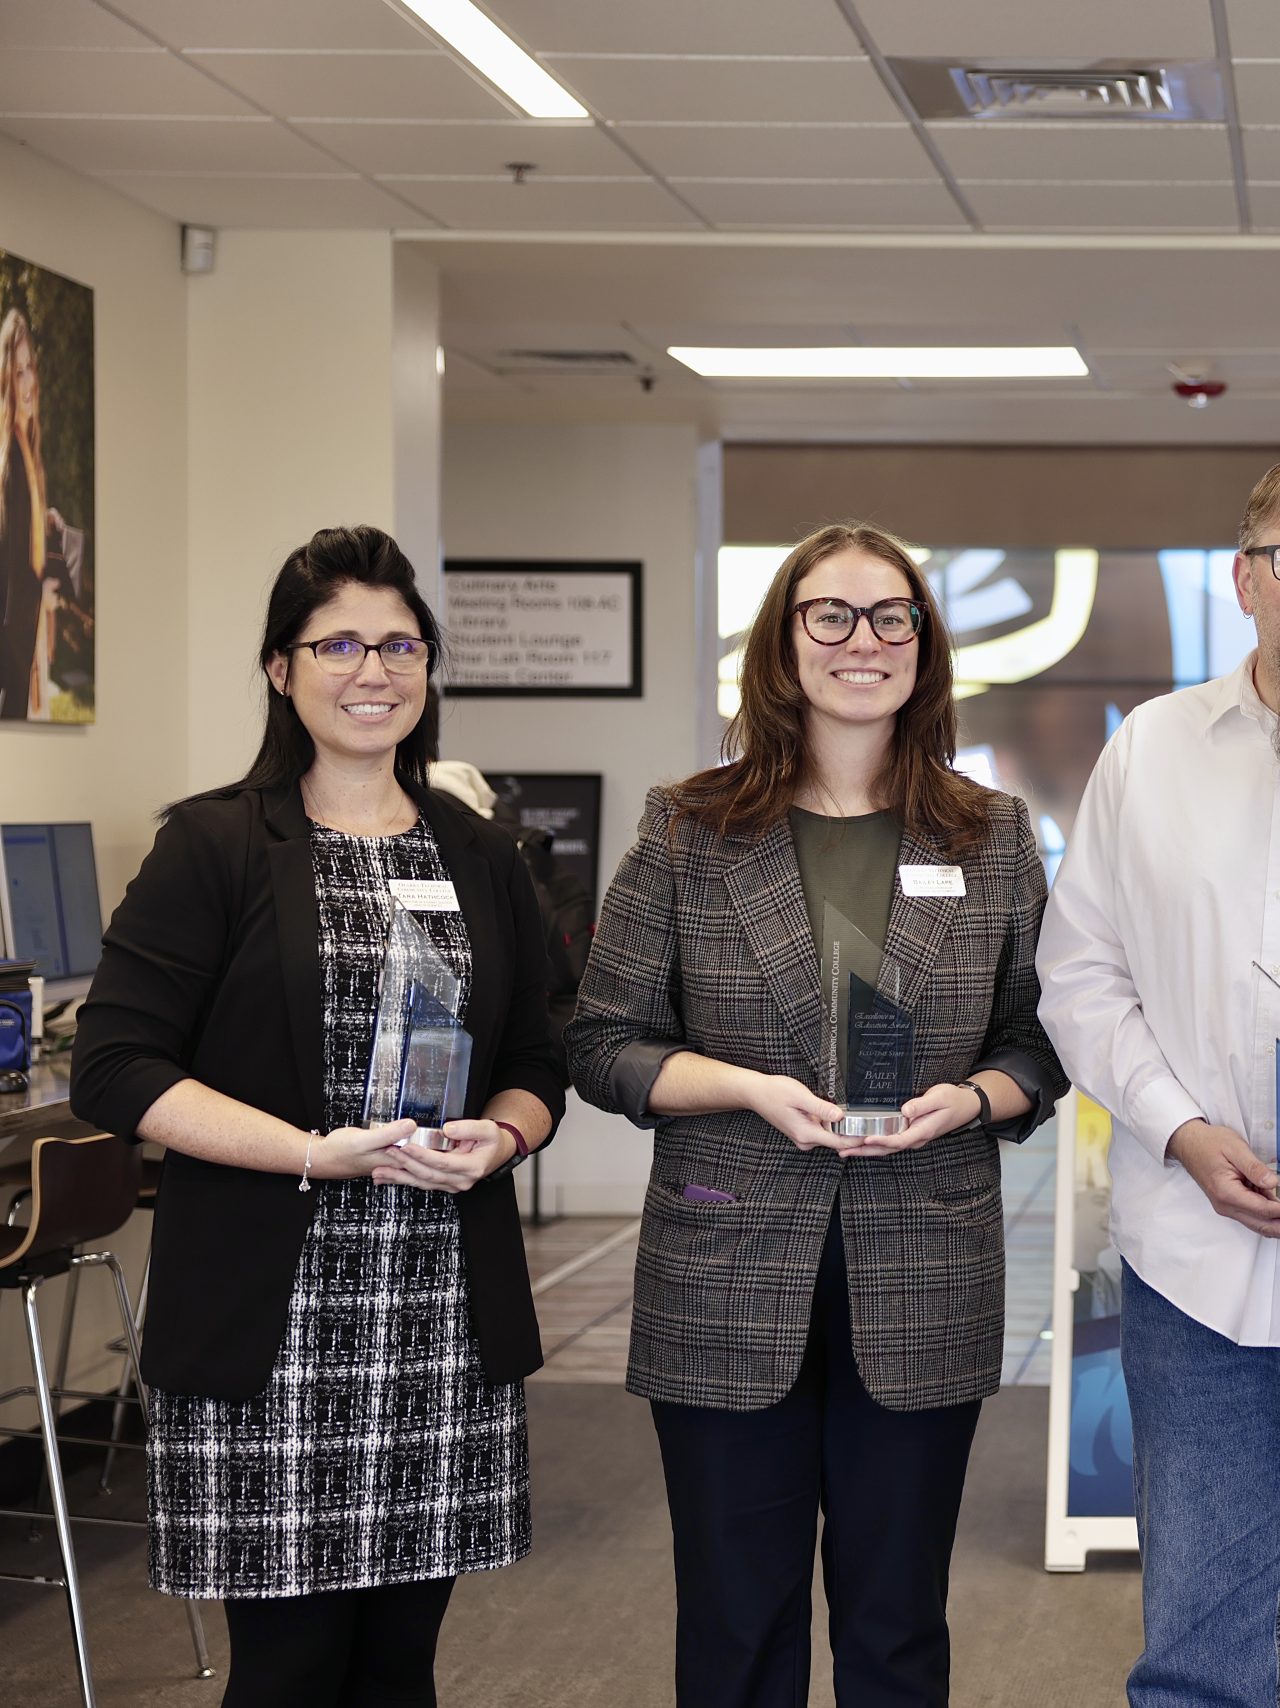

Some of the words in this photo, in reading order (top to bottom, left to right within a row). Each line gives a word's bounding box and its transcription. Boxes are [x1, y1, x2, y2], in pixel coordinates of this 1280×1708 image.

[831, 941, 841, 976] COLLEGE
[830, 977, 840, 1024] COMMUNITY
[829, 1026, 838, 1068] TECHNICAL
[864, 1070, 898, 1080] BAILEY
[869, 1080, 893, 1089] LAPE
